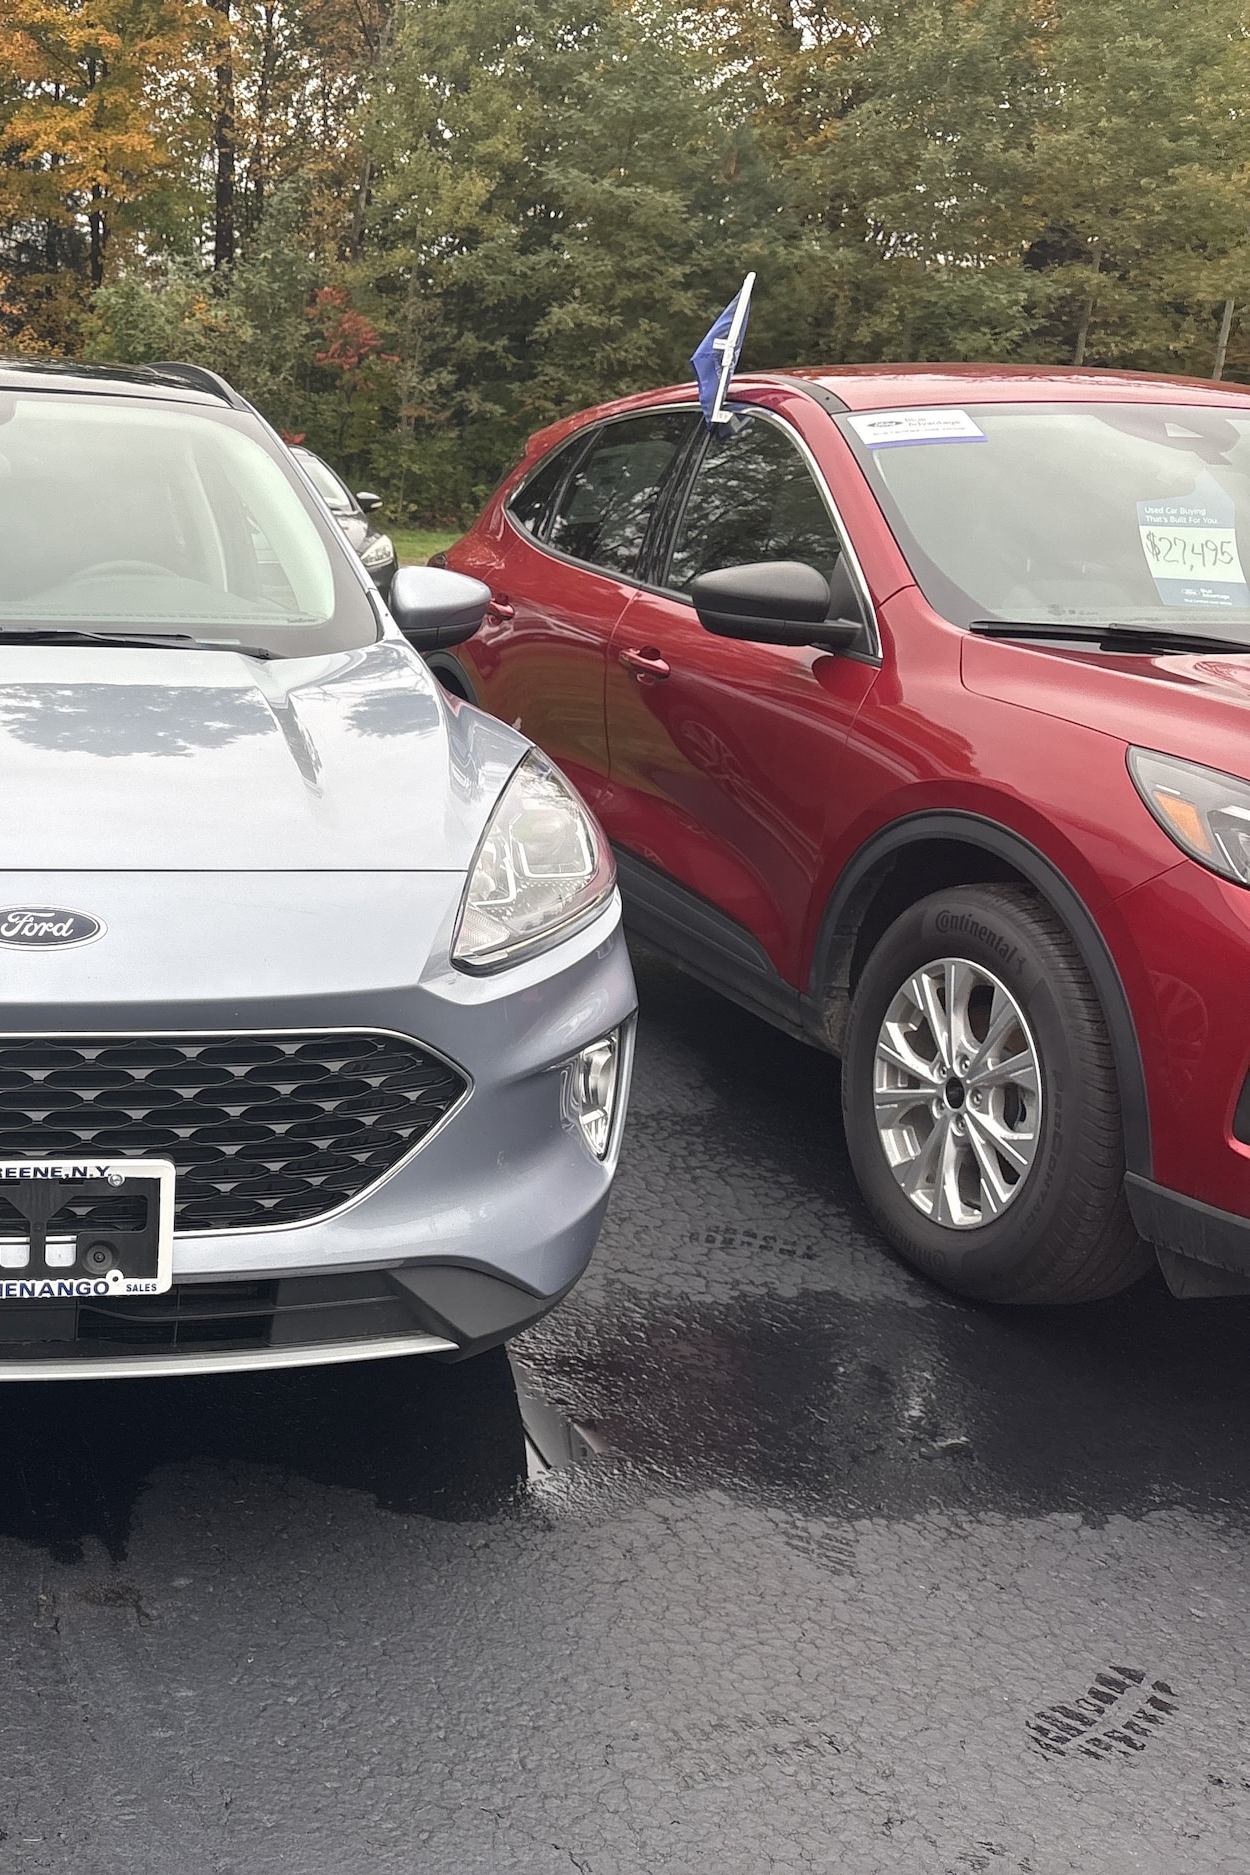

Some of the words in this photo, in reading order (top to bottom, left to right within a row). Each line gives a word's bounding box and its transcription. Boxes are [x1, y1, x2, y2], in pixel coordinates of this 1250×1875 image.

[1144, 506, 1164, 514] Used
[1165, 506, 1178, 514] Car
[1179, 507, 1206, 516] Buying
[1145, 515, 1169, 523] That's
[1169, 515, 1187, 524] Built
[1188, 516, 1201, 524] For
[1145, 530, 1234, 572] $27,495
[0, 911, 74, 937] Ford
[935, 909, 1019, 963] Continental
[126, 1283, 158, 1293] SALES
